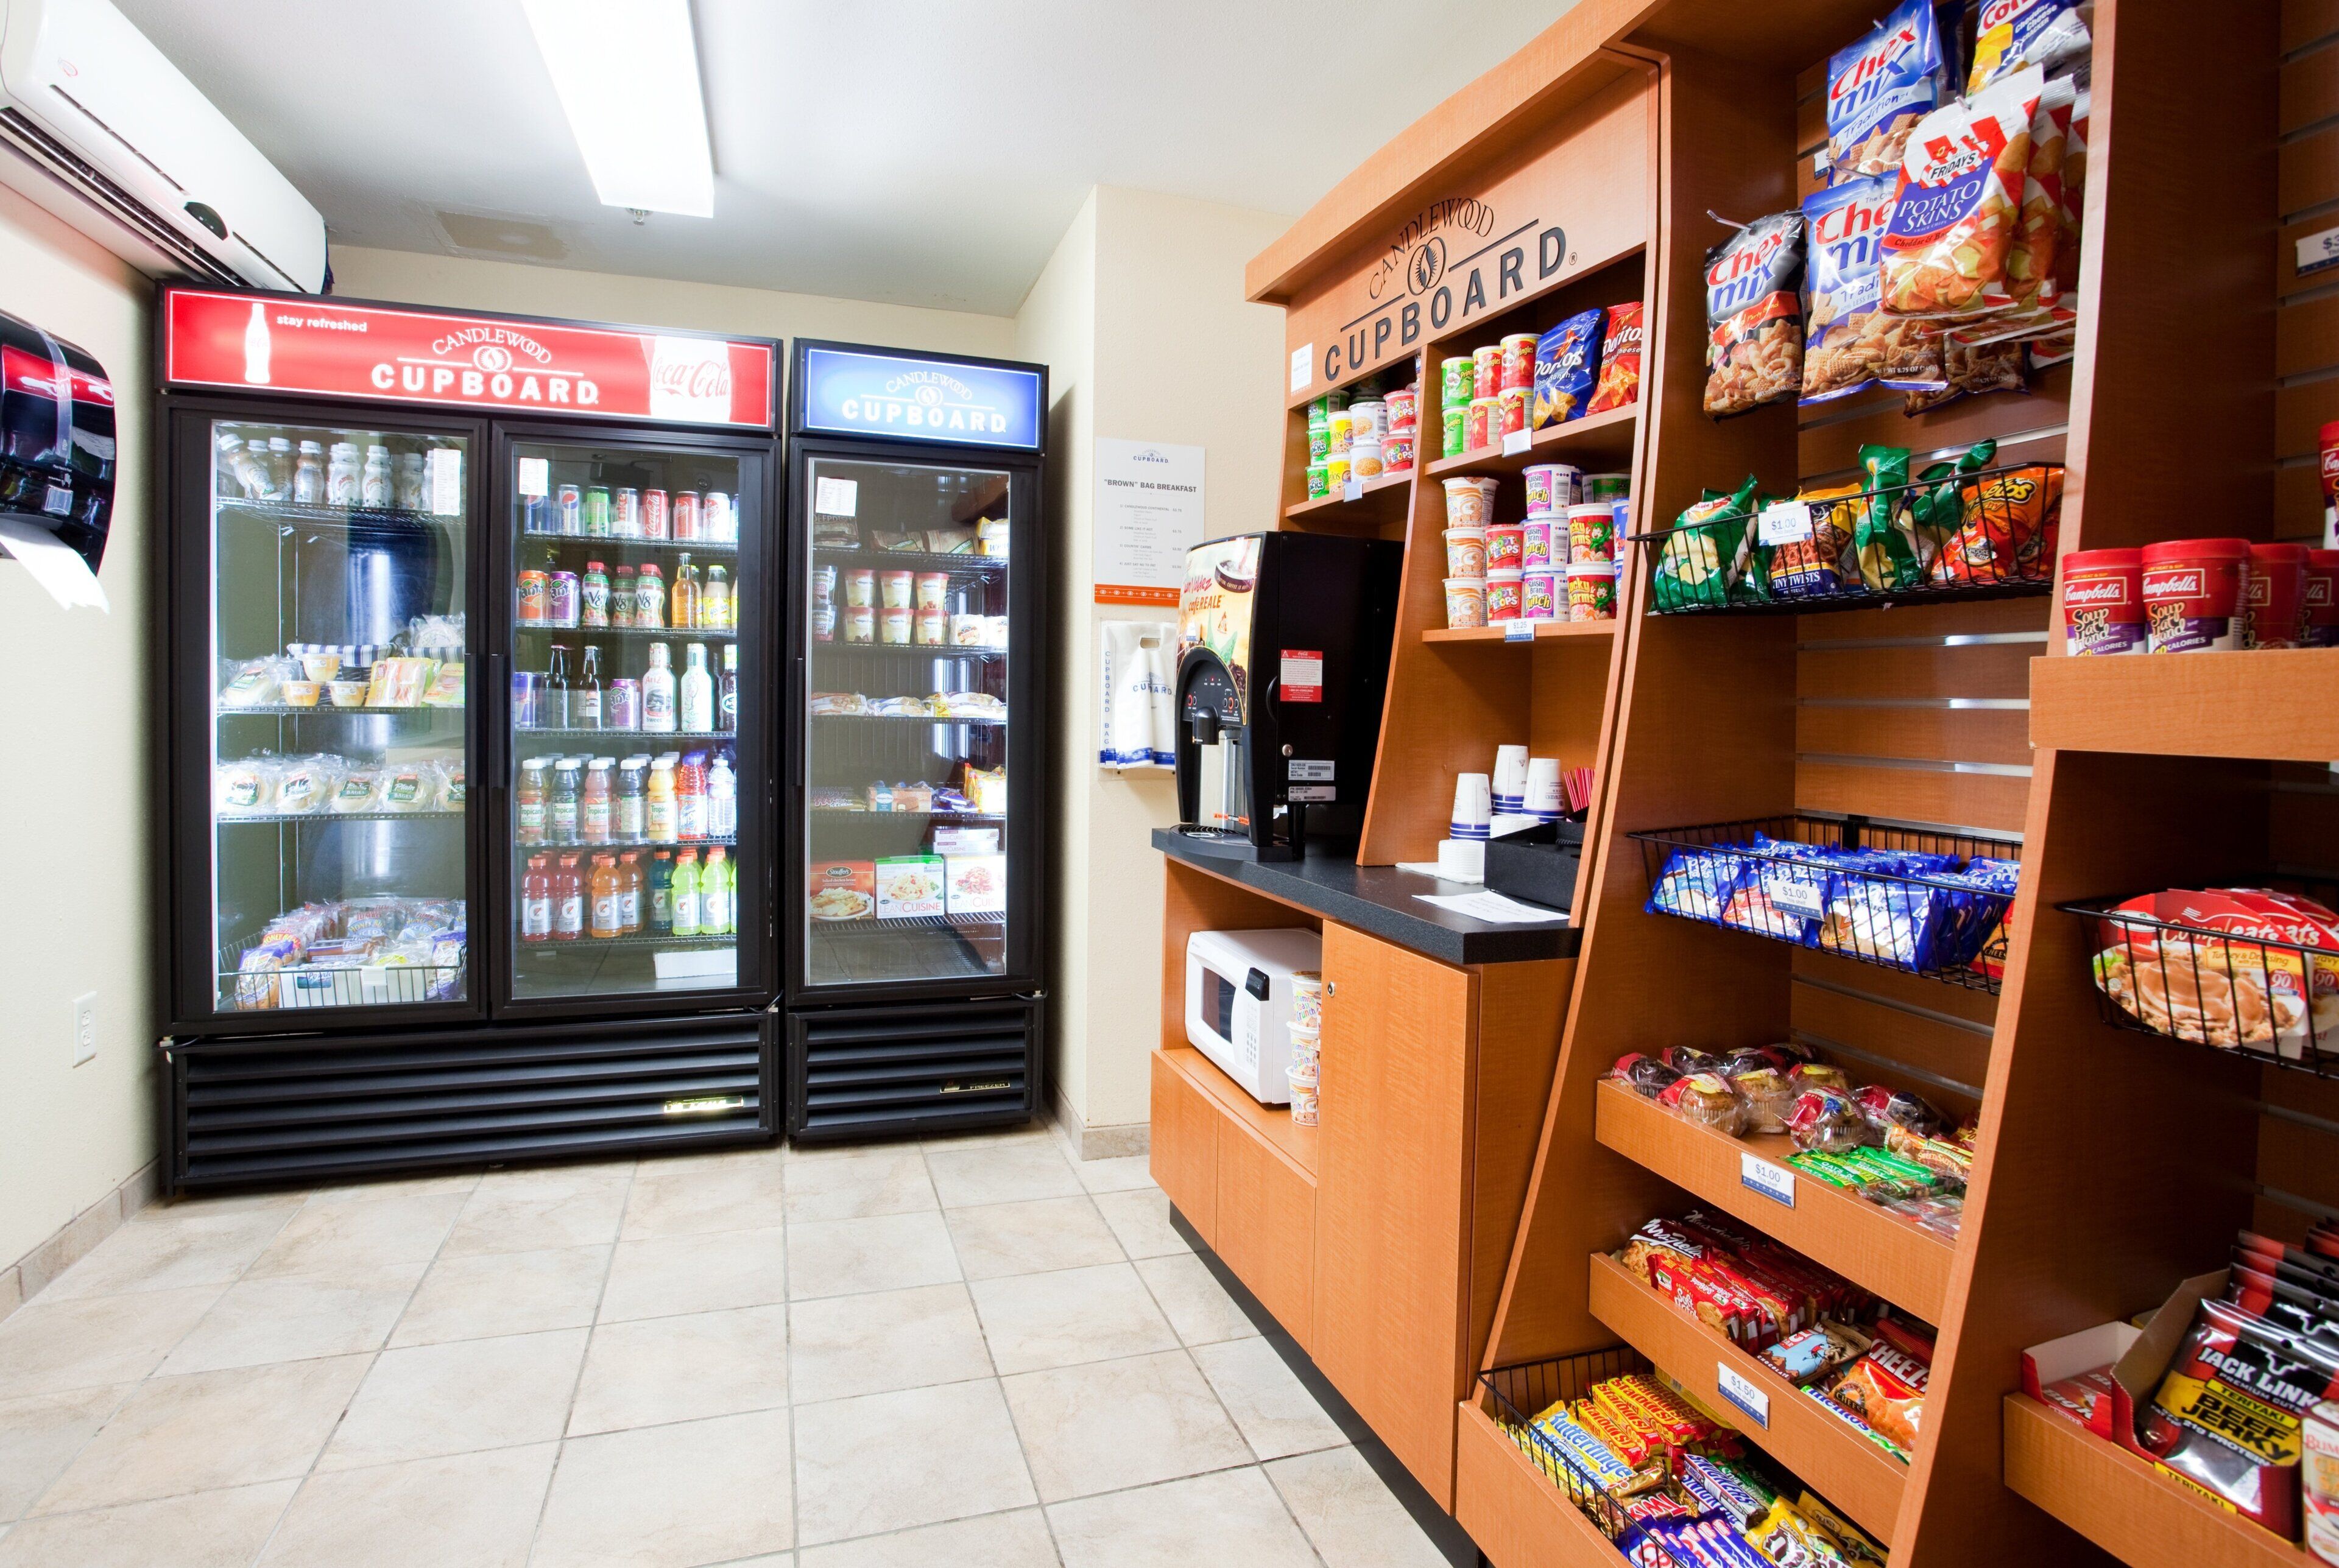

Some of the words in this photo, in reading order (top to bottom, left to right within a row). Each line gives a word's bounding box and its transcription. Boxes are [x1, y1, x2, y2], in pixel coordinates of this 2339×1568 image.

[2027, 5, 2057, 31] Cheese
[1830, 9, 1917, 100] Chex
[1831, 43, 1916, 124] mix
[1899, 180, 1981, 217] POTATO
[1816, 198, 1891, 245] Che
[1903, 200, 1963, 233] SKINS
[1369, 197, 1494, 300] CANDLEWOOD
[1707, 217, 1792, 287] Chex
[1827, 227, 1884, 271] mi
[1894, 234, 1924, 248] Cheddar
[1925, 234, 1932, 243] &
[1711, 247, 1780, 316] mix
[1325, 227, 1567, 381] CUPBOARD
[1853, 298, 1866, 307] LESS
[1867, 291, 1877, 301] FAT
[277, 314, 303, 328] stay
[307, 317, 367, 332] refreshed
[432, 327, 552, 364] CANDLEWOOD
[1602, 326, 1642, 357] Doritos
[371, 364, 598, 404] CUPBOARD
[652, 356, 731, 398] Coca-Cola
[886, 371, 972, 401] CANDLEWOOD
[842, 399, 1007, 433] CUPBOARD
[1157, 483, 1197, 493] BREAKFAST
[1771, 518, 1796, 531] $1.00
[588, 590, 602, 607] V8
[638, 591, 651, 607] V8
[2066, 583, 2120, 602] Campbell's
[2143, 575, 2198, 596] Campbell's
[613, 594, 626, 610] V8
[2150, 602, 2185, 627] Soup
[2073, 608, 2109, 632] Soup
[2086, 621, 2100, 635] at
[2152, 617, 2186, 646] Hand
[2162, 616, 2175, 630] at
[2075, 623, 2109, 652] Hand
[2092, 641, 2128, 654] CALORIES
[2167, 637, 2206, 650] CALORIES
[1782, 886, 1807, 899] $1.00
[880, 904, 901, 913] LEAN
[902, 902, 941, 912] CUISINE
[2271, 973, 2291, 987] 90
[1821, 1162, 1844, 1173] OATS
[1917, 1152, 1936, 1161] SWEET
[1755, 1164, 1780, 1183] $1.00
[1676, 1284, 1693, 1297] ORIGINAL
[1677, 1288, 1693, 1307] Soft
[1757, 1354, 1789, 1379] CHOCOLATE
[1869, 1338, 1928, 1392] CHEEZ-
[2198, 1346, 2257, 1382] JACK
[1612, 1379, 1674, 1422] Starburst
[1731, 1375, 1755, 1400] $1.50
[2218, 1371, 2270, 1399] PREMIUM
[2272, 1397, 2303, 1414] CUTS
[1596, 1385, 1648, 1431] Starburst
[1807, 1389, 1870, 1432] mentos
[1836, 1393, 1866, 1416] CHEESE
[2196, 1392, 2289, 1441] BEEF
[2220, 1385, 2285, 1422] TERIYAKI
[2181, 1402, 2295, 1460] JERKY
[2207, 1431, 2271, 1466] PROTEIN
[1687, 1454, 1759, 1505] SNICKERS
[2166, 1471, 2224, 1508] TERIYAKI
